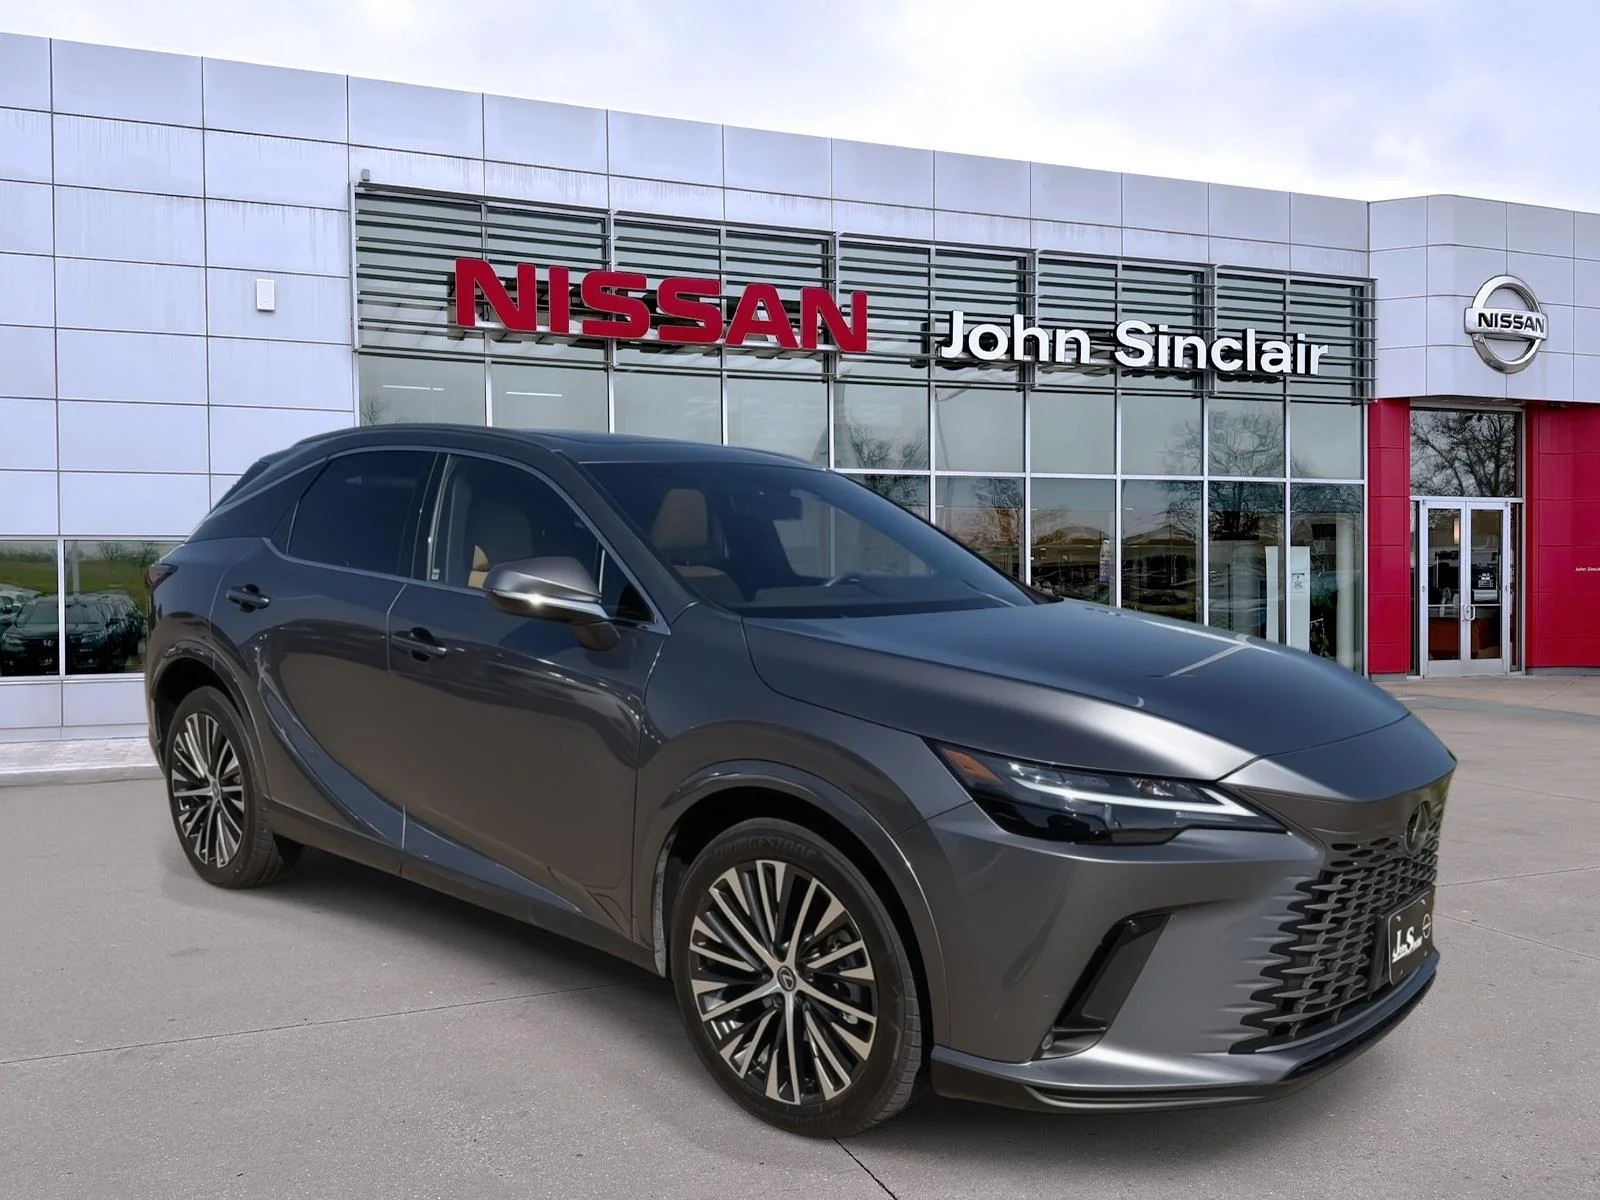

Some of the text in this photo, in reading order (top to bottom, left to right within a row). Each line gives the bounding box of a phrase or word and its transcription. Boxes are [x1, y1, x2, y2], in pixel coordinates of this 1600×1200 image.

[455, 257, 868, 353] NISSAN
[1478, 312, 1544, 333] NISSAN
[940, 310, 1329, 375] John Sinclair
